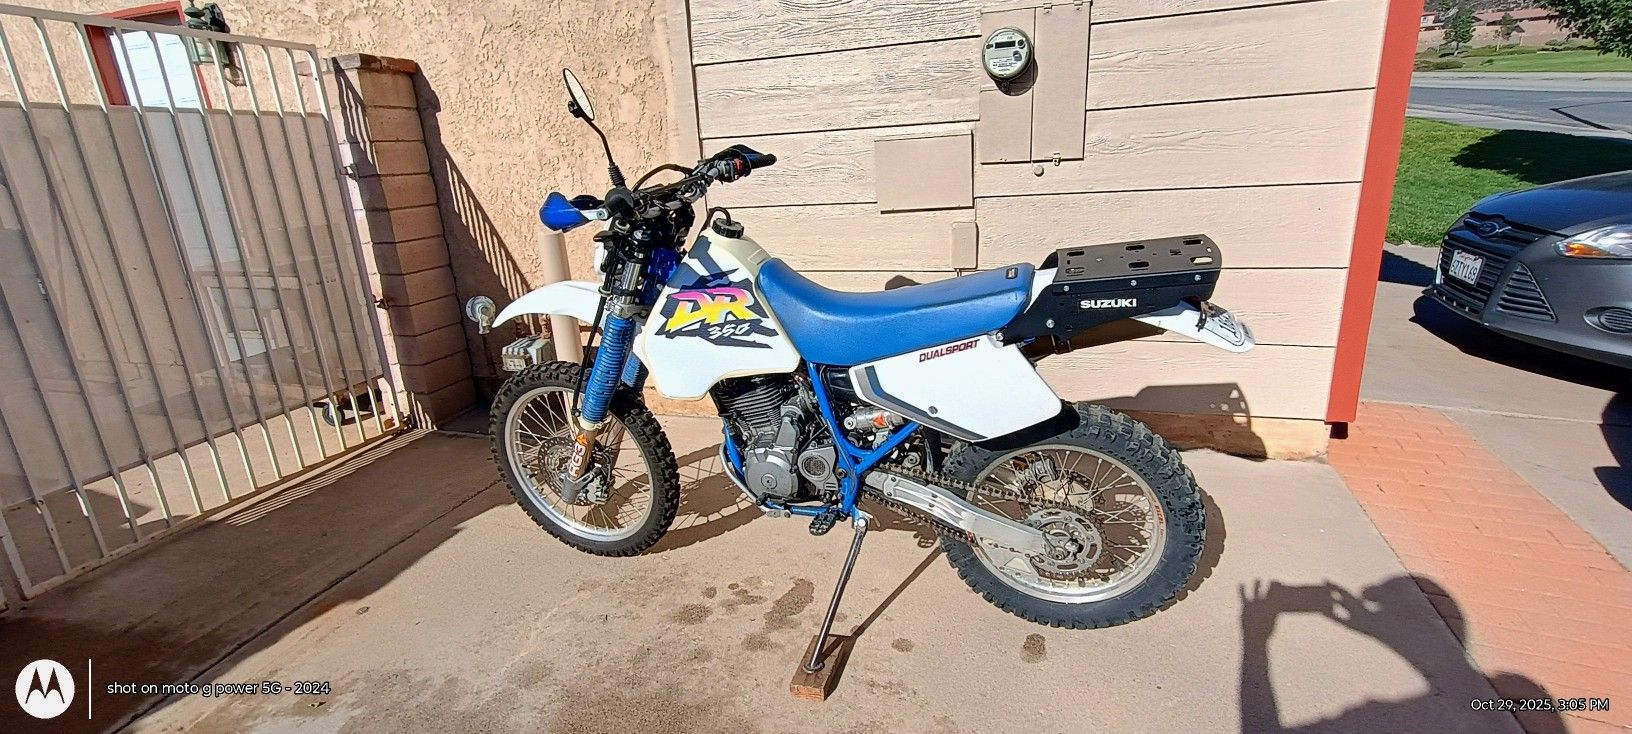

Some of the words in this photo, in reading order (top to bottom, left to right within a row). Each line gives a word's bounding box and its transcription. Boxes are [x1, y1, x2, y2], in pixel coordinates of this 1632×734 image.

[665, 287, 762, 333] DR
[1080, 298, 1137, 309] SUZUKI
[708, 322, 751, 340] 350
[919, 339, 980, 363] DUALSPORT
